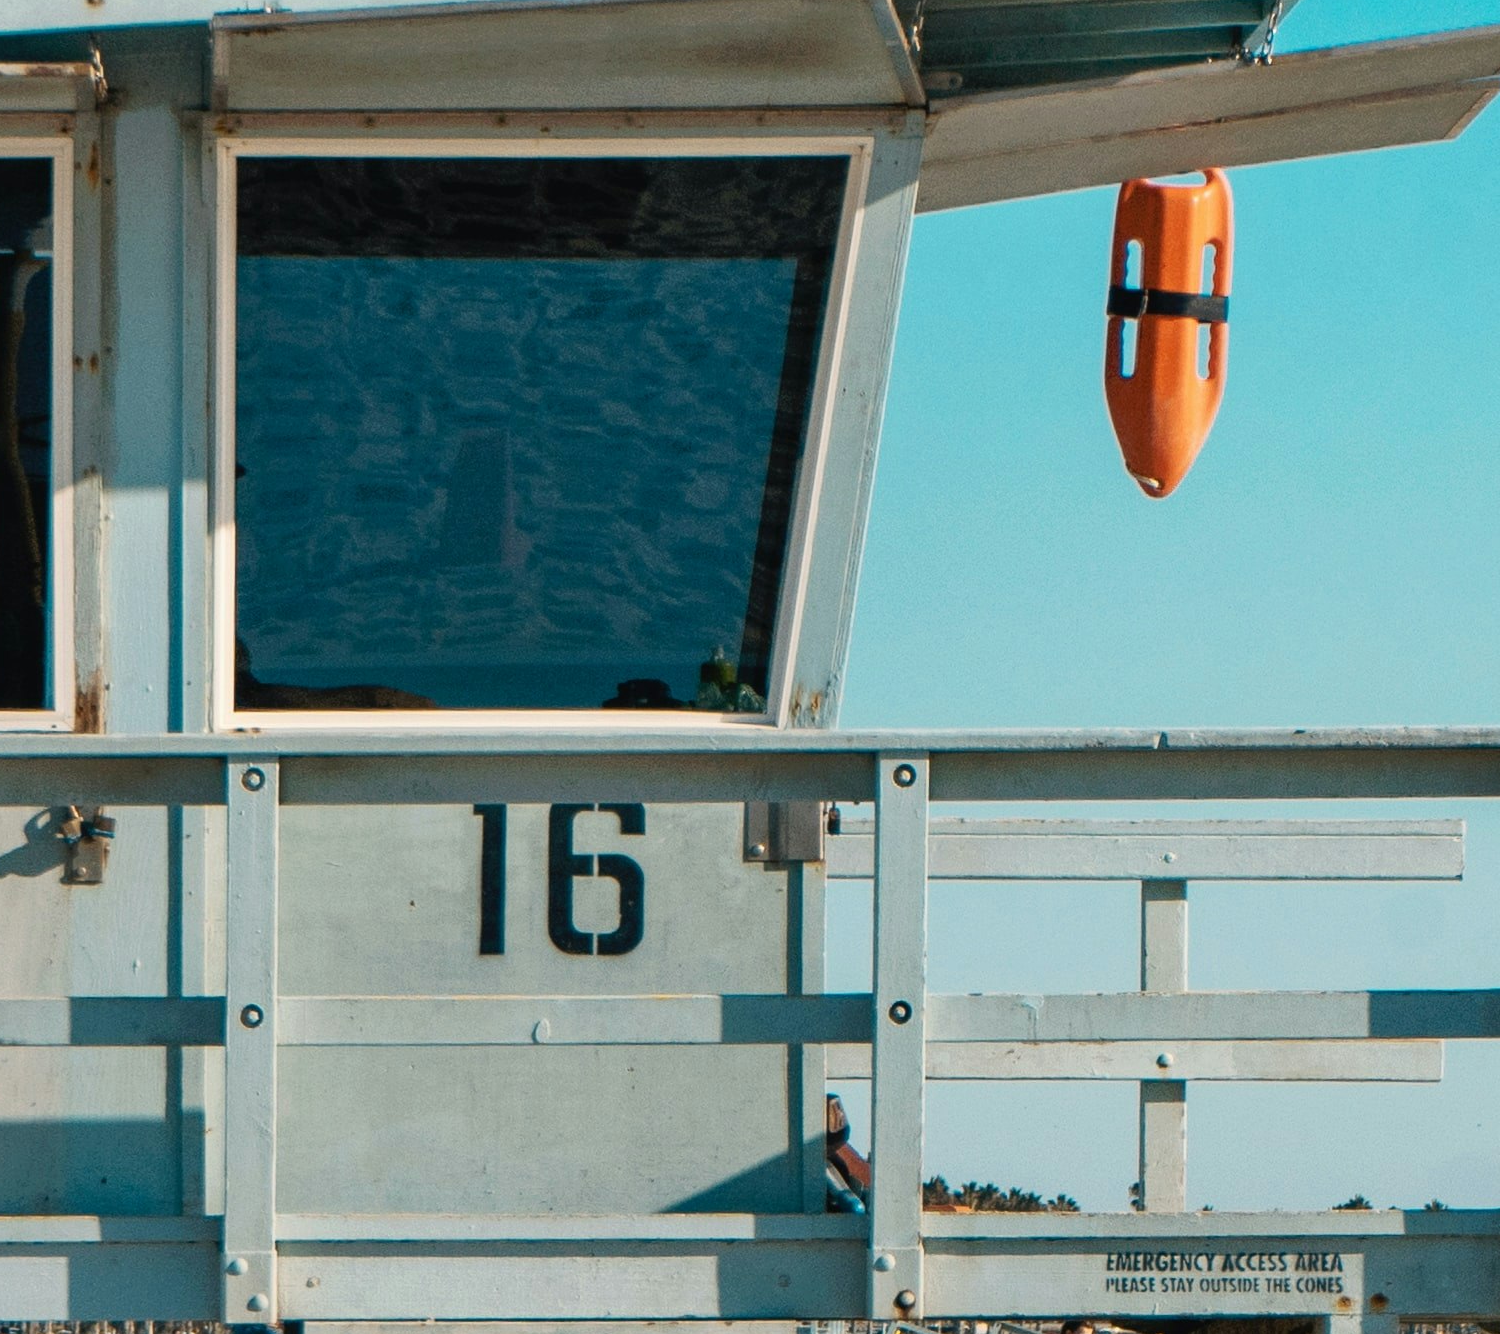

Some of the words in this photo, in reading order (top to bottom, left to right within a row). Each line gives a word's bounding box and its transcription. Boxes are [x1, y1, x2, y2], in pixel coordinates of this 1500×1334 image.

[473, 801, 646, 956] 16
[1106, 1251, 1216, 1272] EMERGENCY
[1221, 1251, 1288, 1272] ACCESS
[1295, 1251, 1343, 1272] AREA
[1106, 1277, 1156, 1293] PLEASE
[1161, 1277, 1194, 1293] STAY
[1200, 1277, 1260, 1293] OUTSIDE
[1266, 1277, 1291, 1293] THE
[1296, 1277, 1344, 1293] CONES
